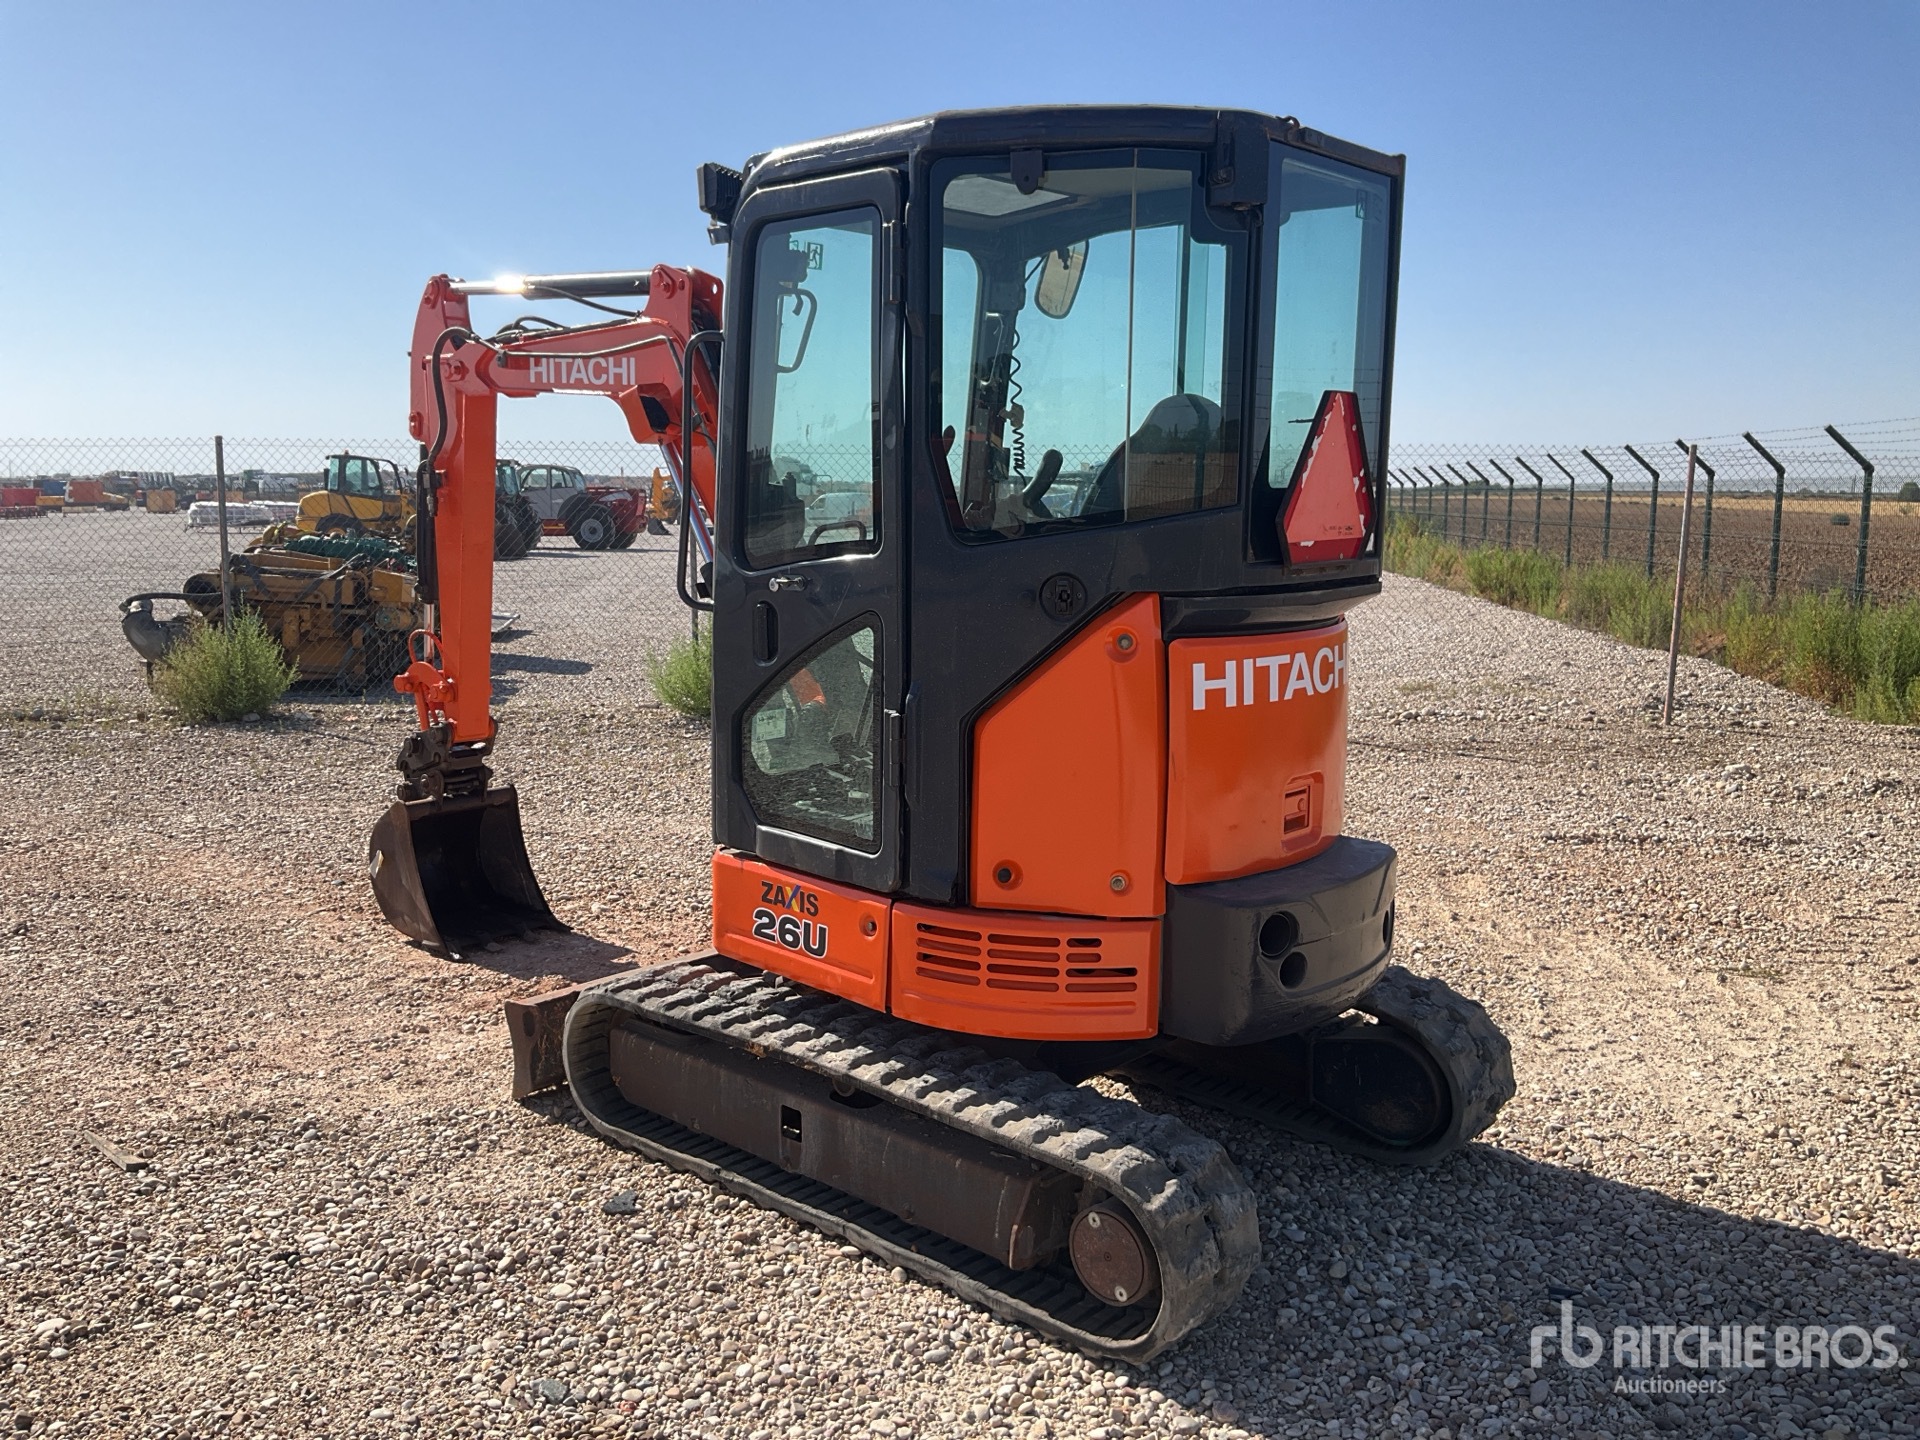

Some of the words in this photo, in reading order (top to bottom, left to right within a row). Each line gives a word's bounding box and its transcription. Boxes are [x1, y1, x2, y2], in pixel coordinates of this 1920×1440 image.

[529, 356, 636, 386] HITACHI
[1192, 643, 1347, 711] HITACH
[761, 880, 819, 917] ZAXIS
[752, 907, 829, 959] 26U
